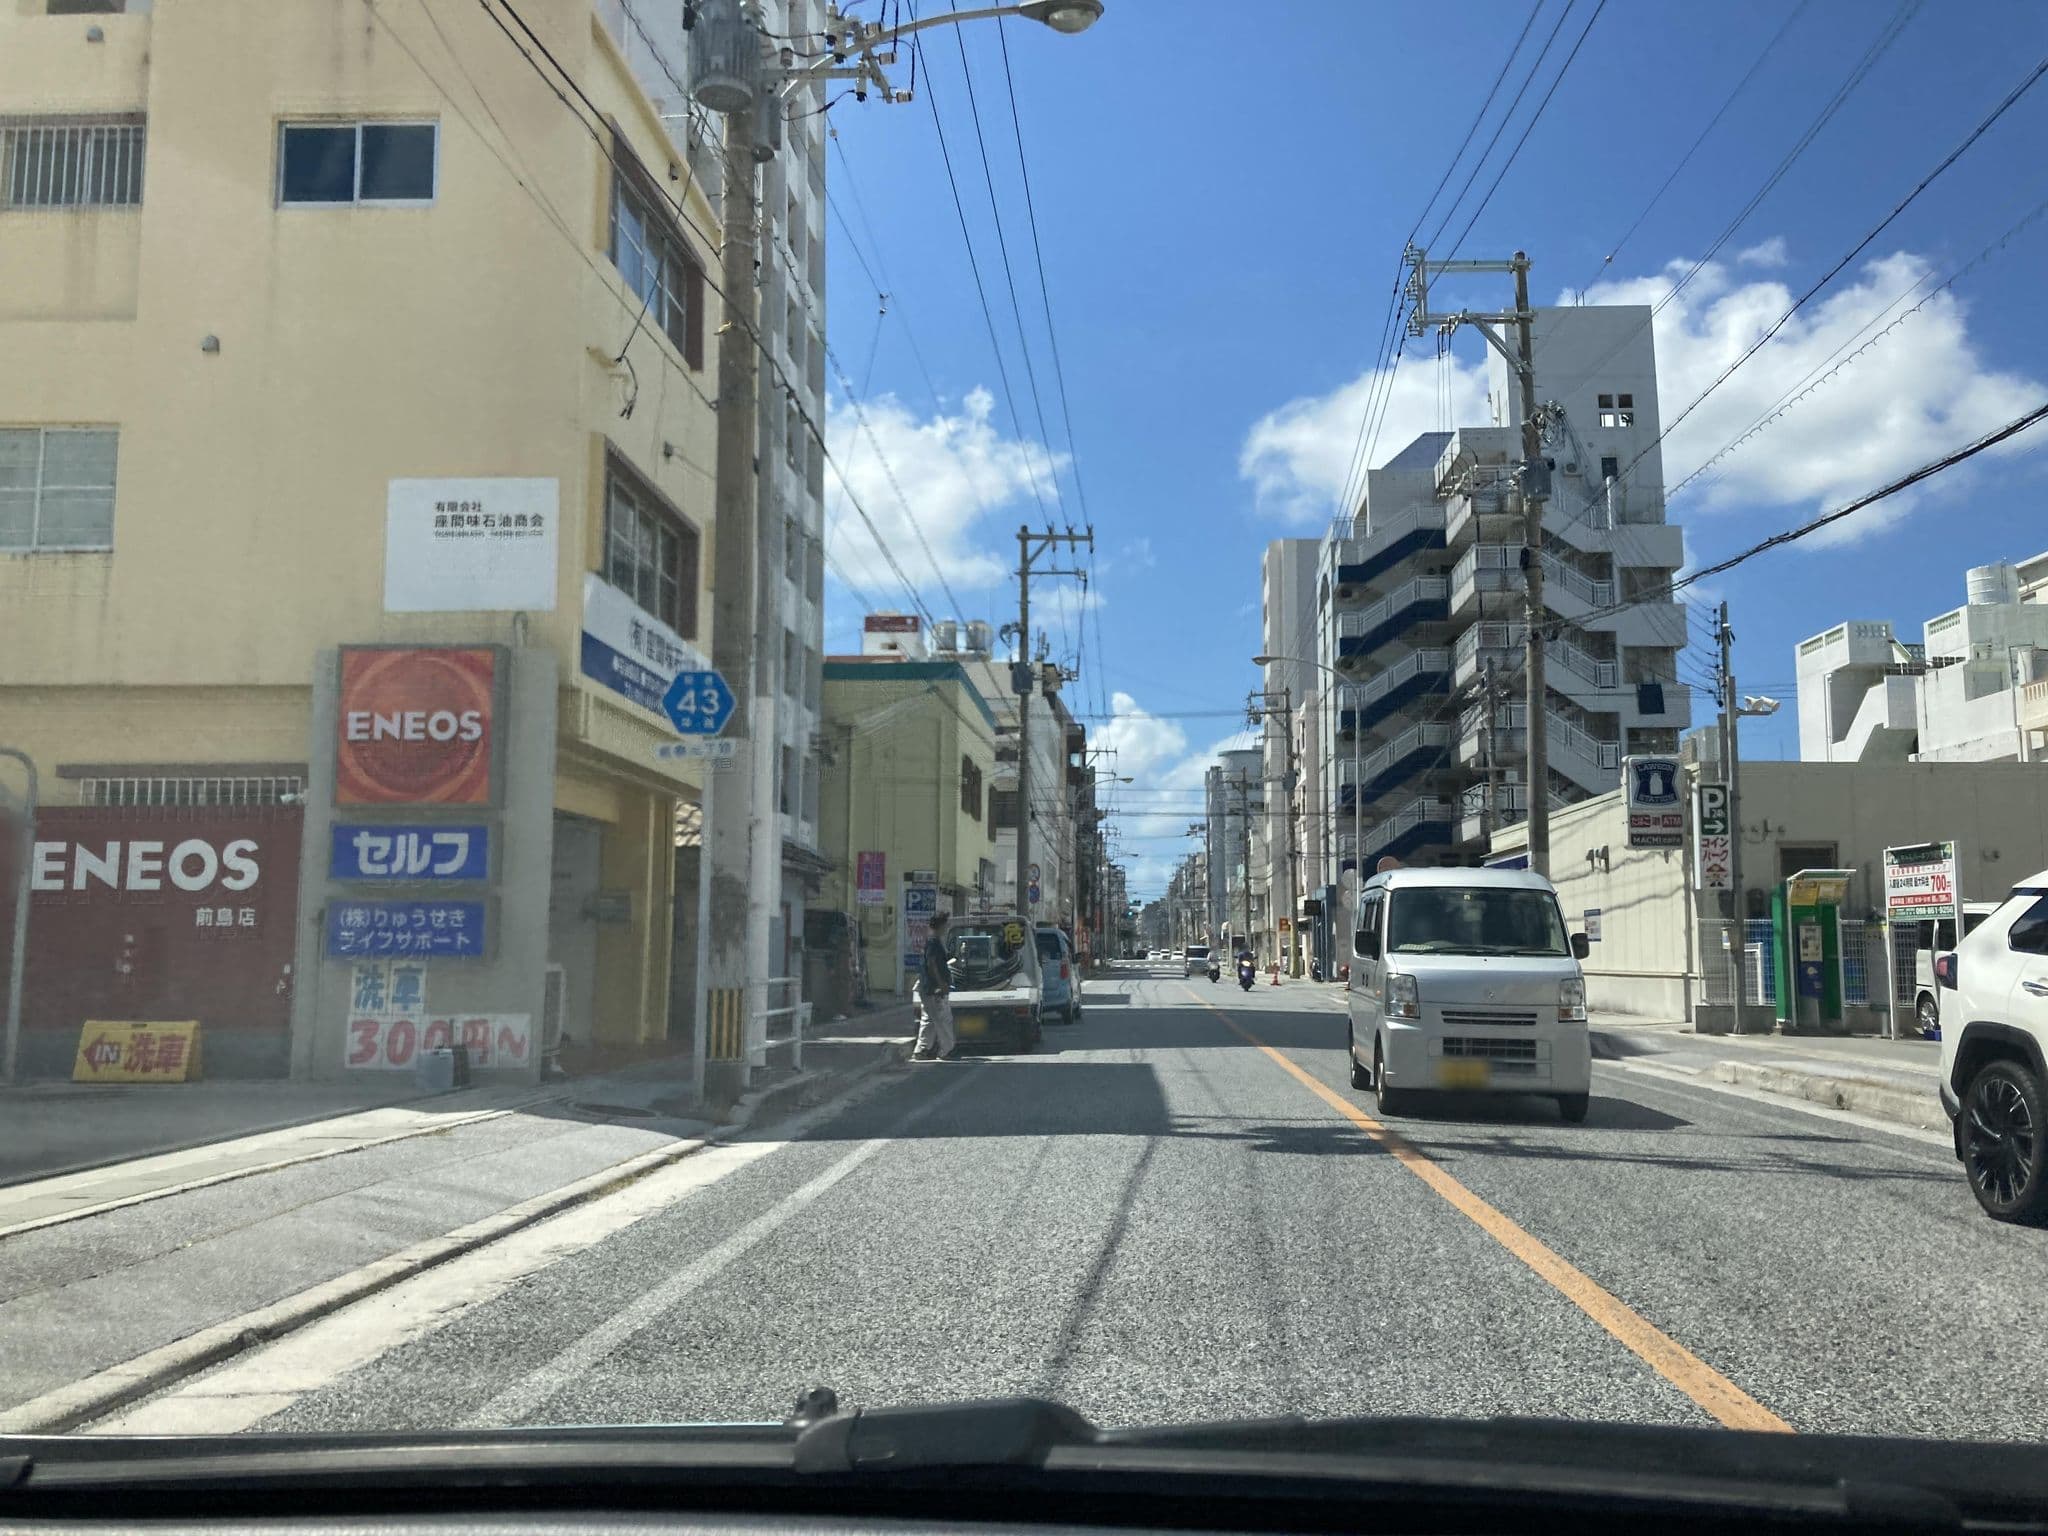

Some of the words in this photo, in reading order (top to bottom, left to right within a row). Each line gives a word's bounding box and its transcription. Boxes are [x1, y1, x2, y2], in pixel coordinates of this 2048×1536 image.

[435, 501, 482, 512] 有限会社
[434, 514, 545, 528] 座間味石油商会
[677, 689, 720, 715] 43
[347, 710, 483, 741] ENEOS
[1702, 788, 1725, 818] P
[1663, 815, 1681, 827] ATM
[353, 830, 469, 875] セルフ
[1701, 837, 1728, 848] コイン
[31, 838, 259, 891] ENEOS
[196, 908, 256, 927] 前島店
[340, 908, 466, 929] (株)りゅうせき
[354, 964, 424, 1011] 洗車
[94, 1044, 120, 1062] IN
[124, 1032, 187, 1073] 洗車
